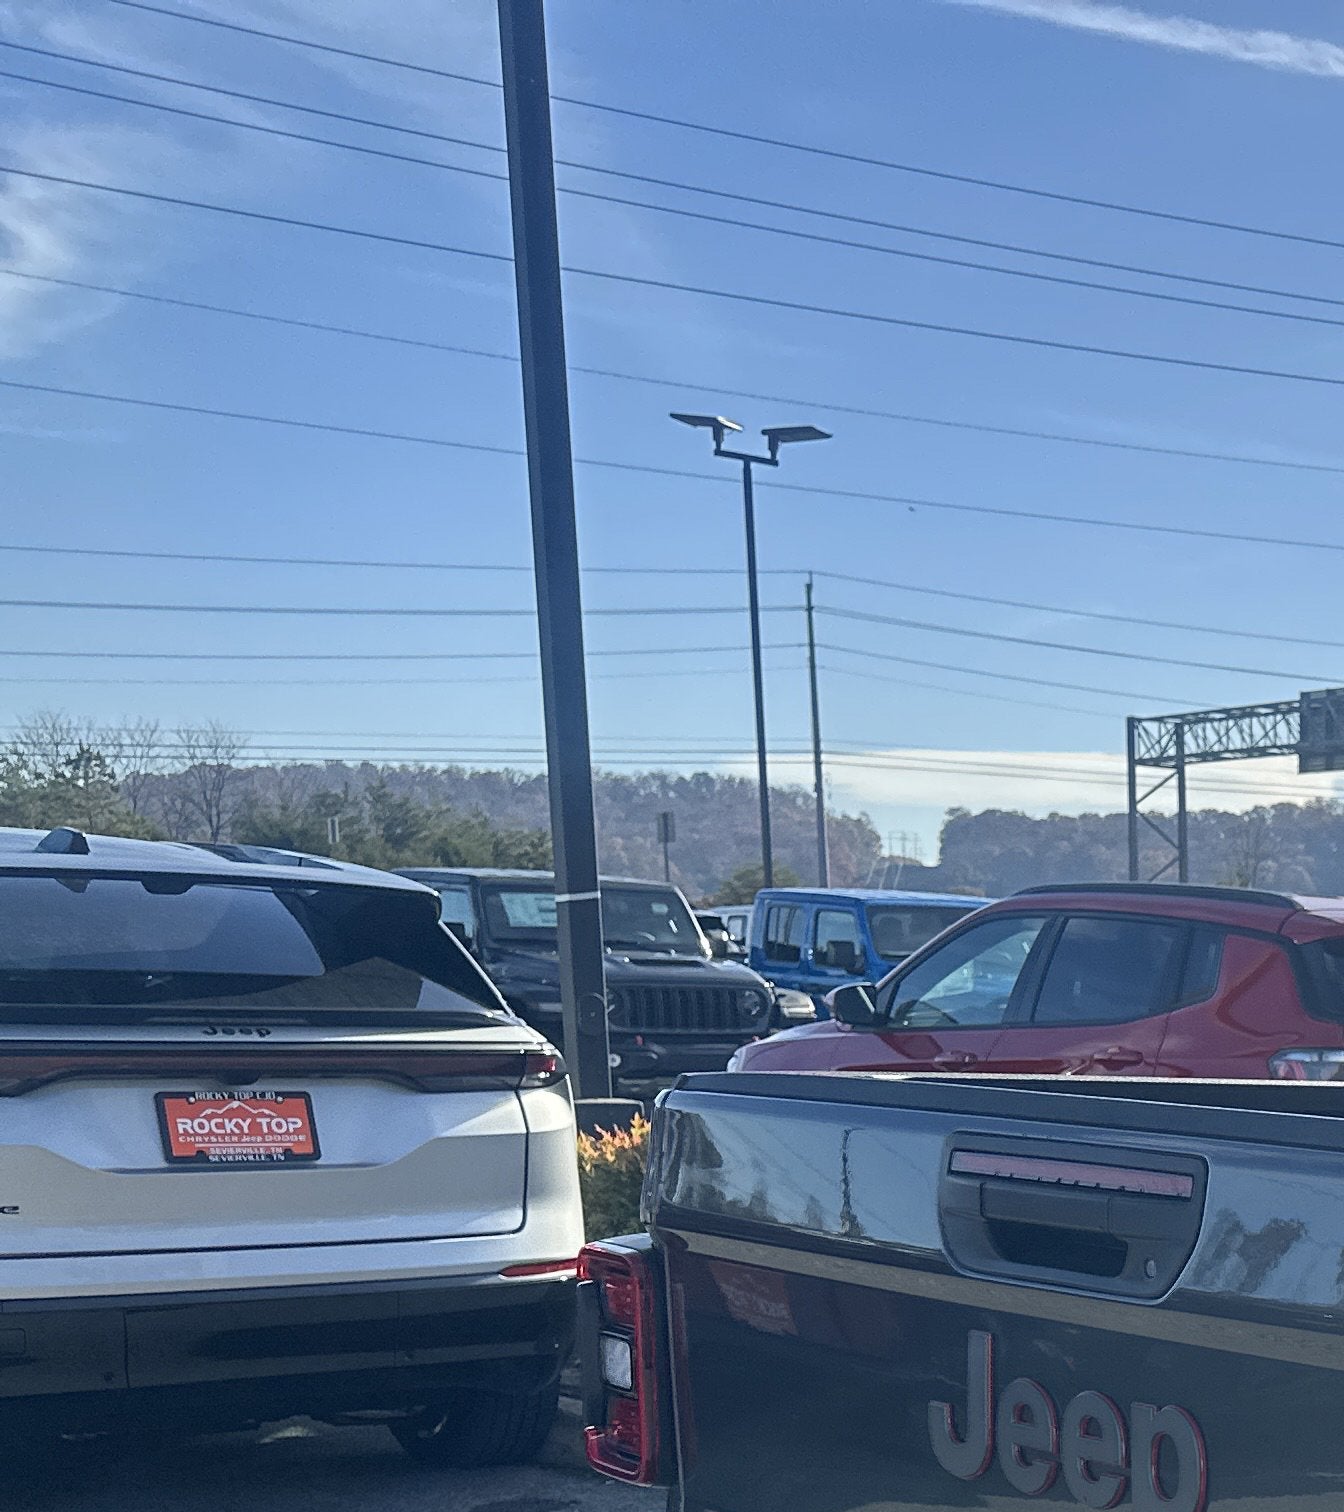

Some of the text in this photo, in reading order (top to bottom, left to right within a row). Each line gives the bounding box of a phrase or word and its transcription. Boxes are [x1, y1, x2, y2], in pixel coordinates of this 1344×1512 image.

[203, 1025, 271, 1038] Jeep
[176, 1117, 302, 1134] ROCKY TOP
[178, 1134, 306, 1143] CHRYSLER Jeep DODGE
